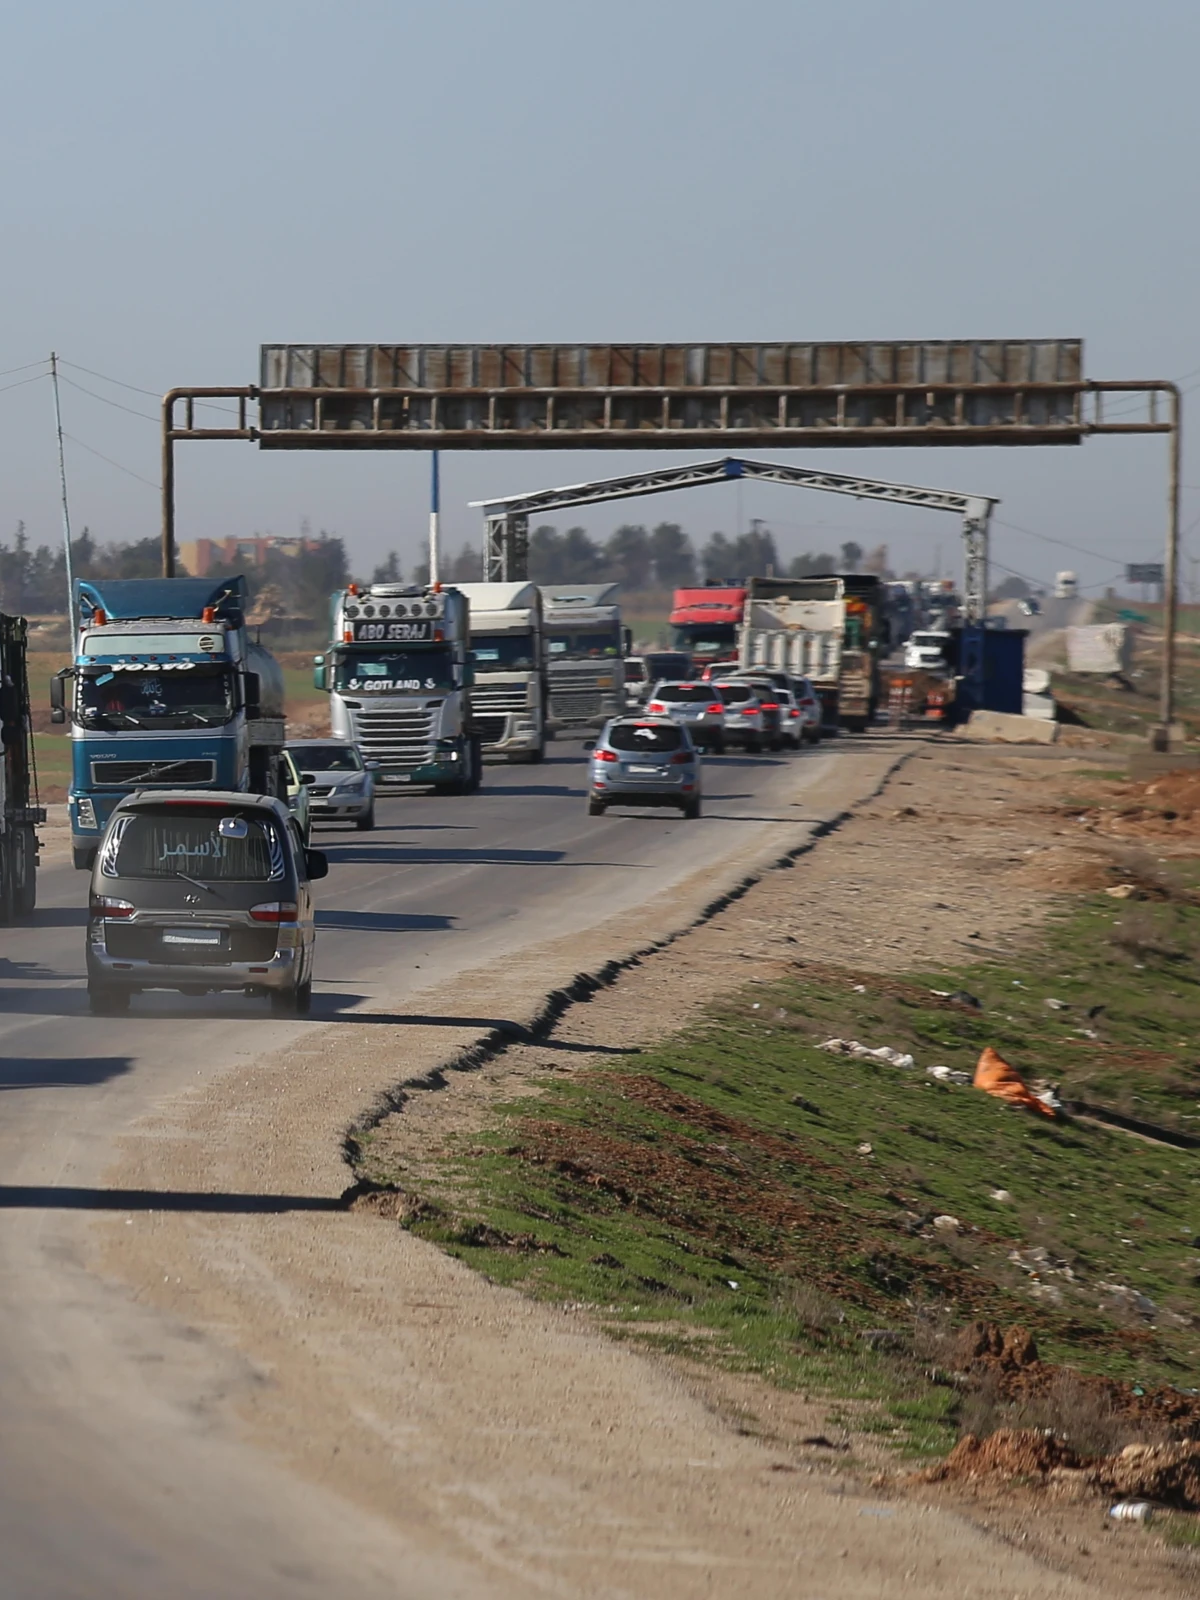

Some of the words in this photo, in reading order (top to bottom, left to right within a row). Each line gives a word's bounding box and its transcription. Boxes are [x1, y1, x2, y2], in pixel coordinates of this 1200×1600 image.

[358, 624, 384, 640] ABO
[387, 624, 426, 640] SERAJ
[110, 663, 196, 672] VOLVO
[363, 680, 420, 690] GOTLAND
[159, 831, 228, 861] الأسمر
